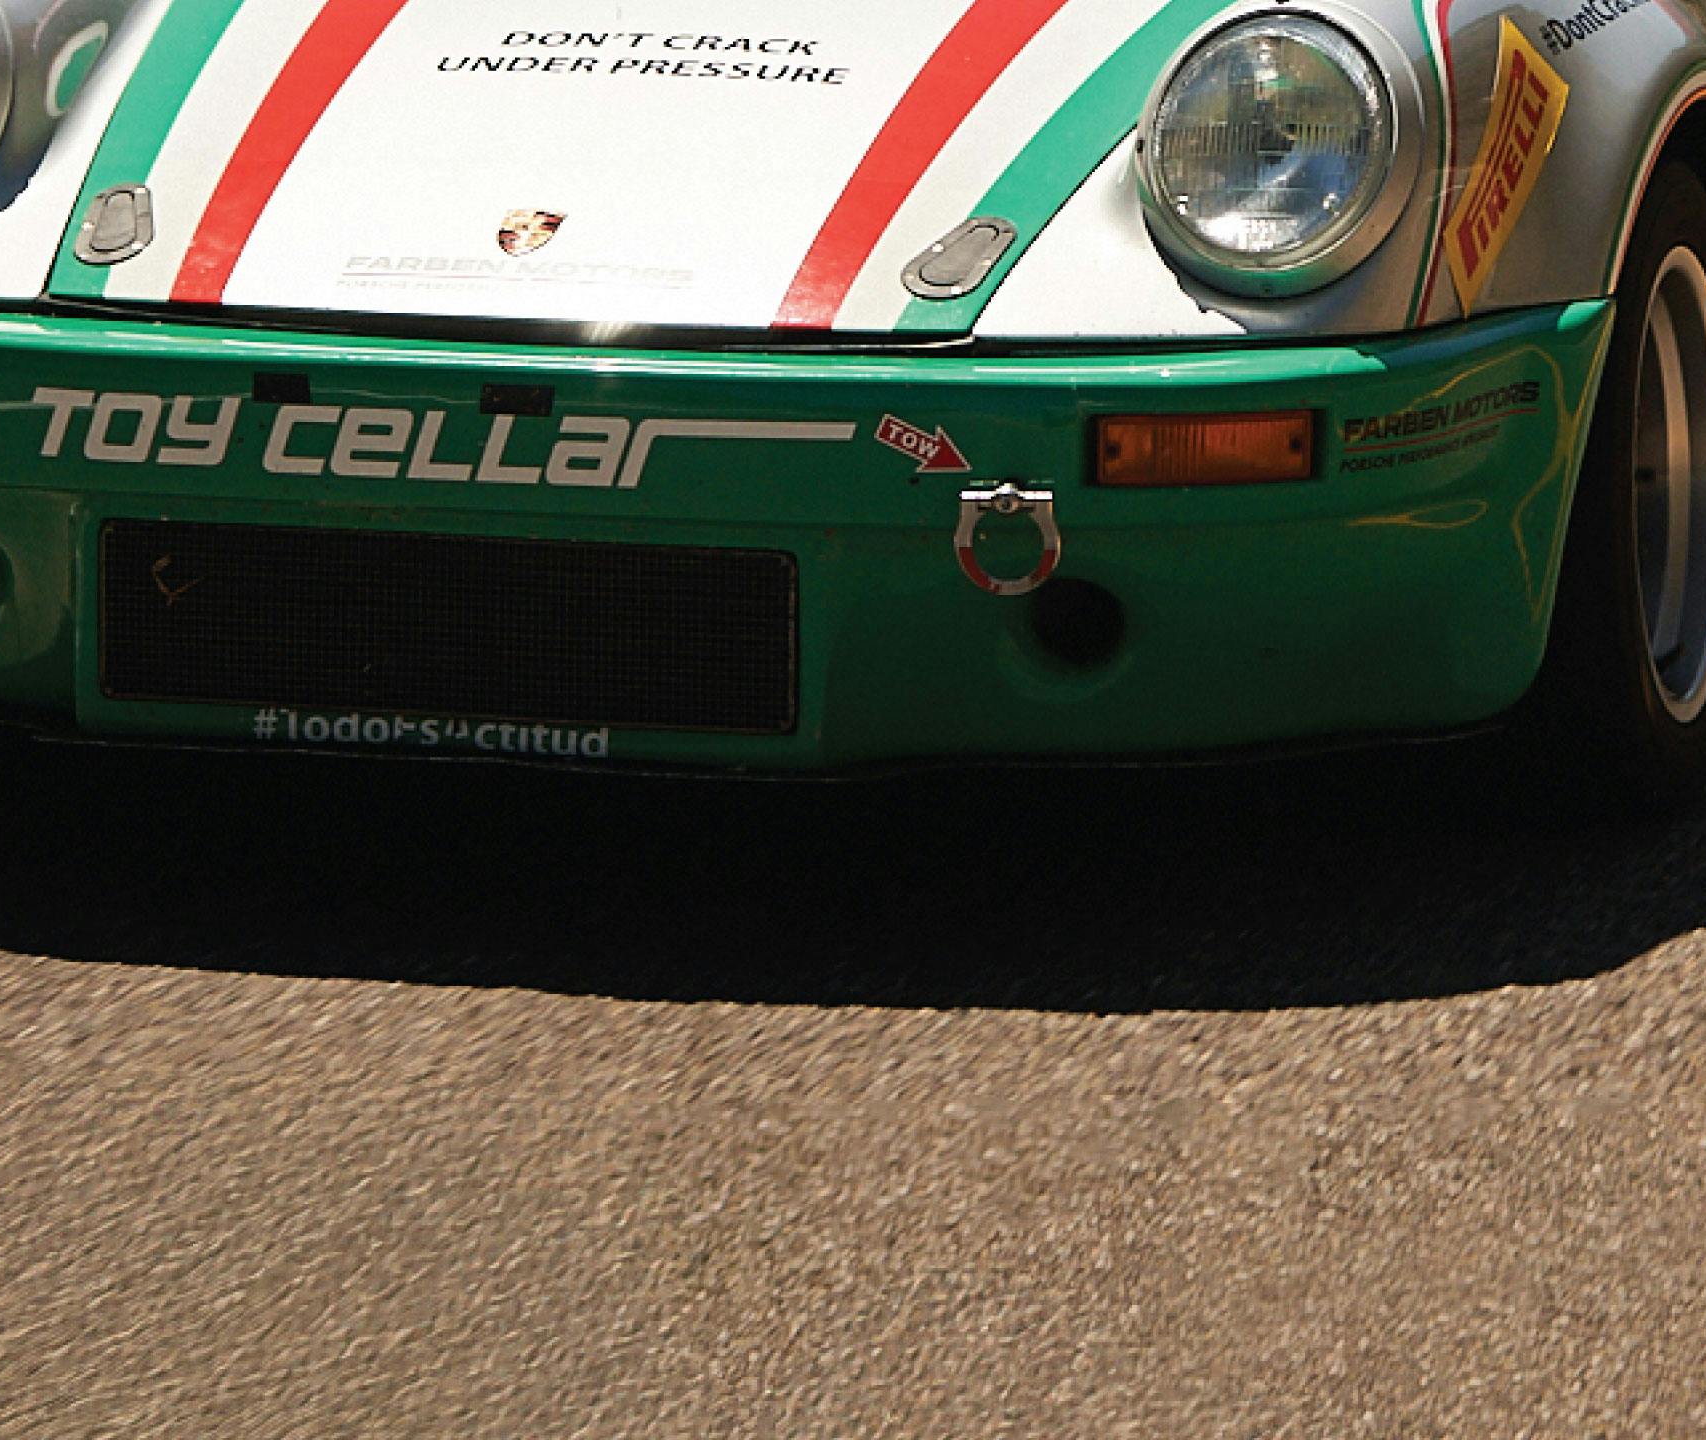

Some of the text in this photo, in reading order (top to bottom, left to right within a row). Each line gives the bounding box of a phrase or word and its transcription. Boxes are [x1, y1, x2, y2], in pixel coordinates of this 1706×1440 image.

[501, 30, 821, 57] DON'T CRACK
[437, 56, 851, 86] UNDER PRESSURE
[1457, 48, 1548, 280] PIRELLI
[32, 386, 242, 466] TOY
[889, 423, 941, 458] TOW
[1344, 406, 1447, 442] FARBEN
[253, 708, 609, 758] #Todosctitud
